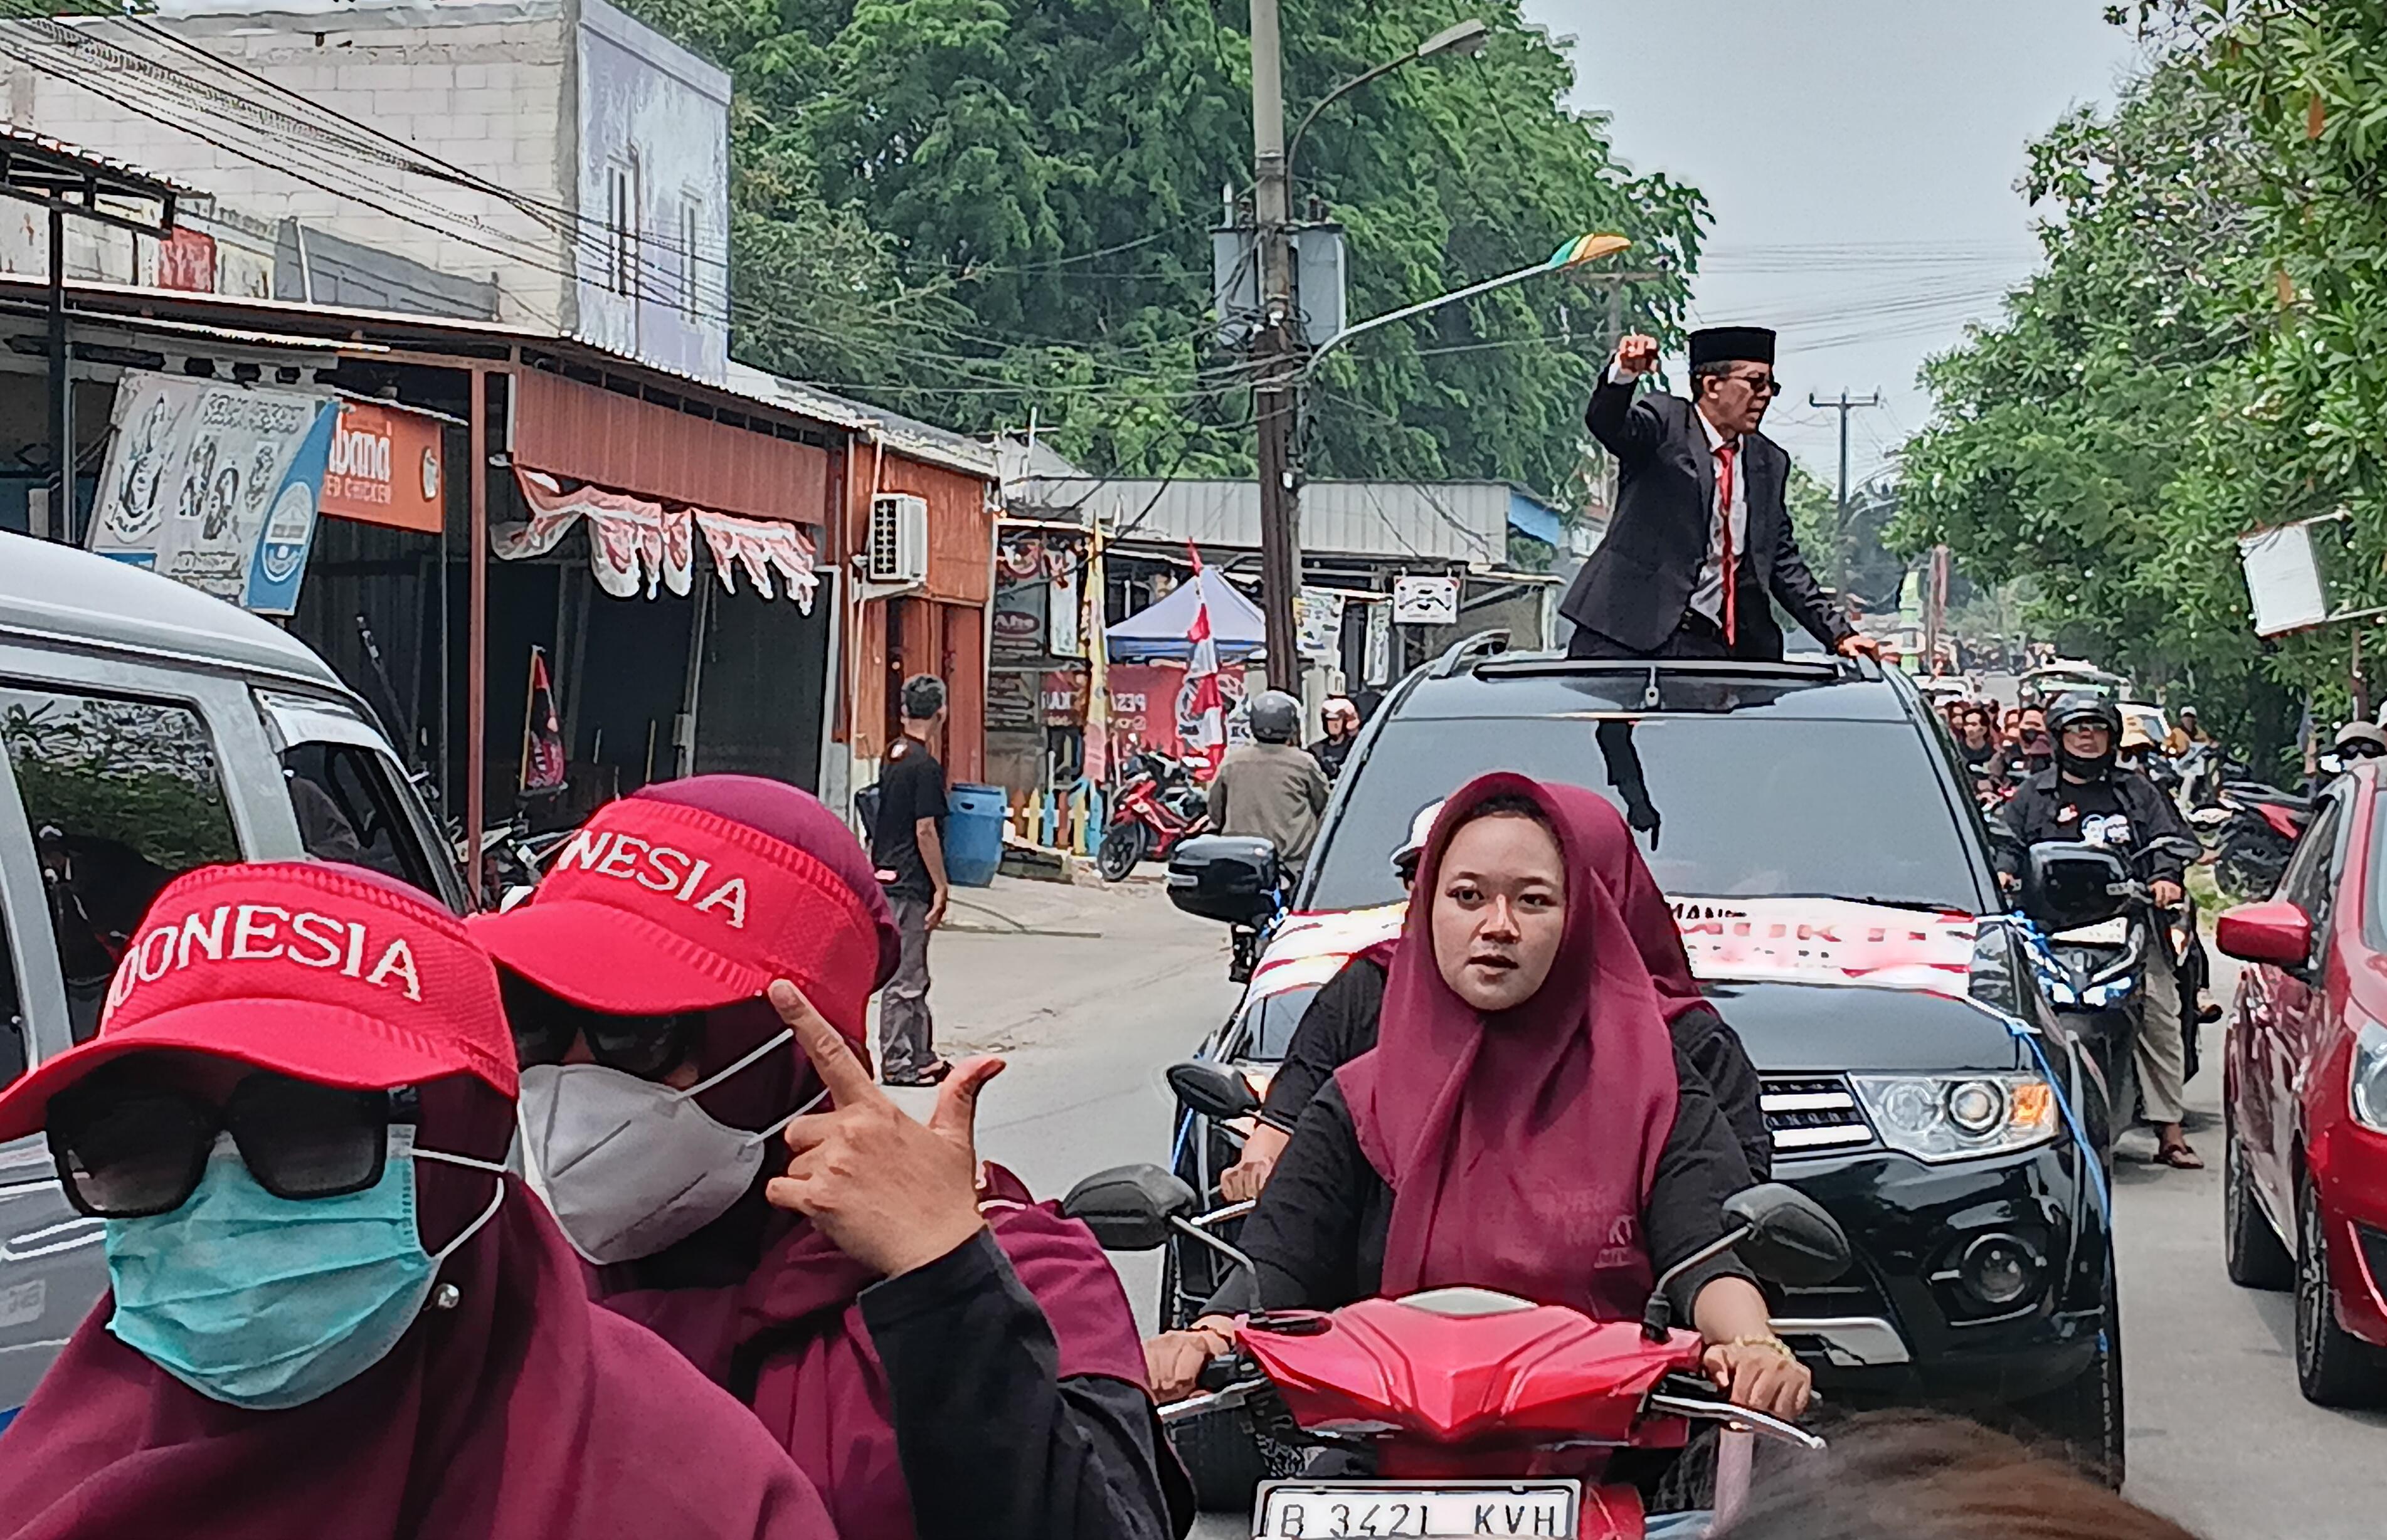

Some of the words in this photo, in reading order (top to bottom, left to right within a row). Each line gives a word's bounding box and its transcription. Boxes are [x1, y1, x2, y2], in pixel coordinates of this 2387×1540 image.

[1282, 1504, 1304, 1536] B
[1329, 1503, 1428, 1536] 3421
[1474, 1504, 1555, 1536] KVH
